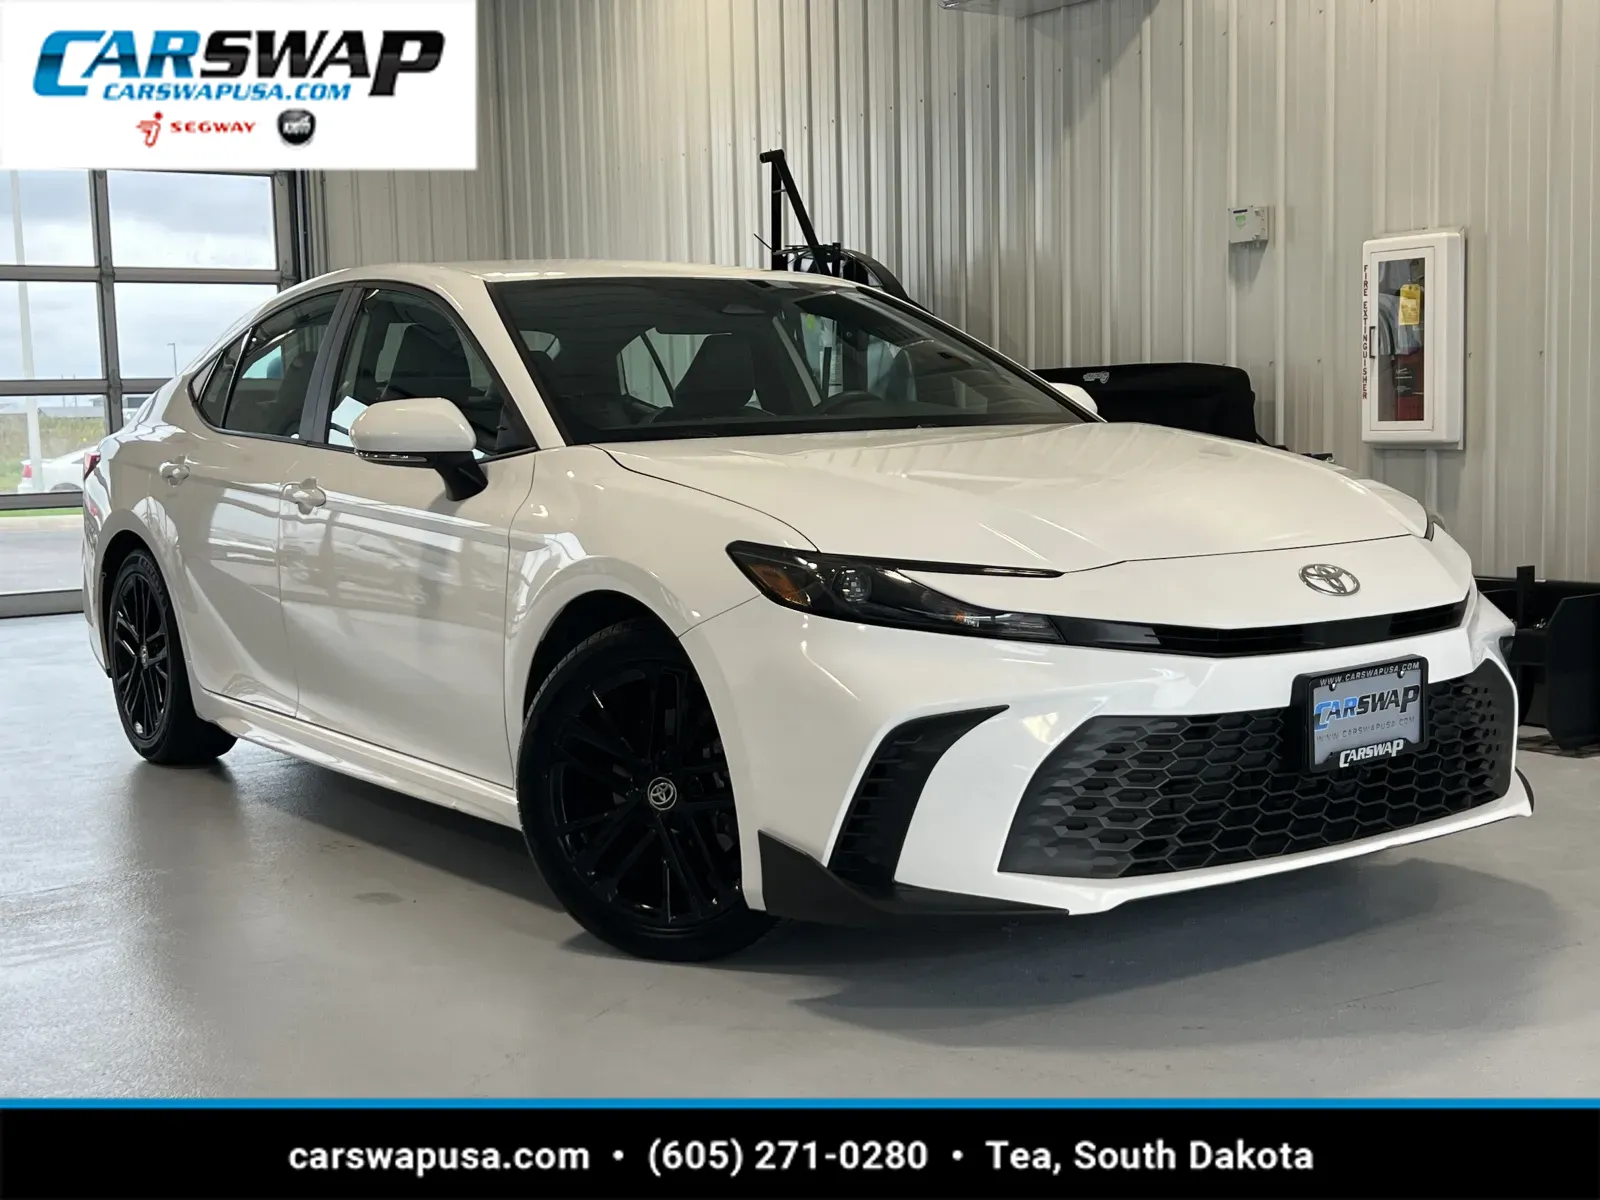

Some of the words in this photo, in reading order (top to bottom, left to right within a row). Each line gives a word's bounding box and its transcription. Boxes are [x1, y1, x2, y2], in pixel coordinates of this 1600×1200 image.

[1320, 661, 1420, 687] WWW.CARSWAPUSA.COM
[1314, 684, 1420, 732] CARSWAP
[1316, 716, 1415, 741] WWWCARSWAPUSACOM
[1339, 738, 1404, 768] CARSWAP
